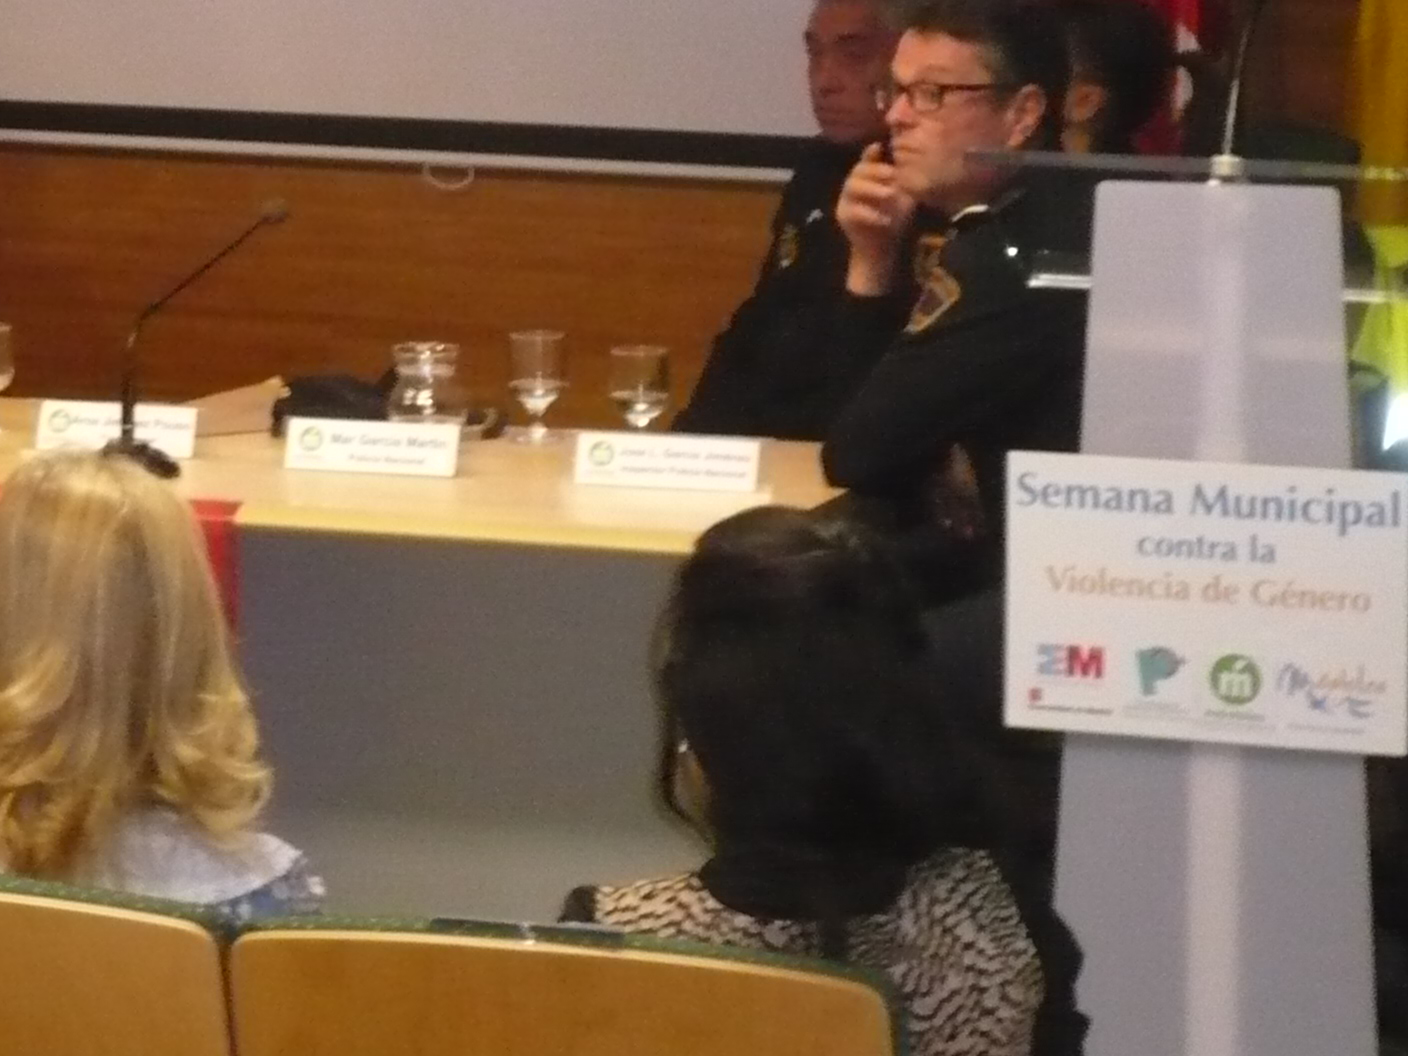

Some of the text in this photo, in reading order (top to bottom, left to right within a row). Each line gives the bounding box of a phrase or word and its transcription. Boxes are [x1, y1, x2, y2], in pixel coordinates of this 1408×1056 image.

[1016, 471, 1401, 537] Semana Municipal
[1137, 534, 1277, 564] contra la
[1044, 565, 1373, 614] Violencia de Género
